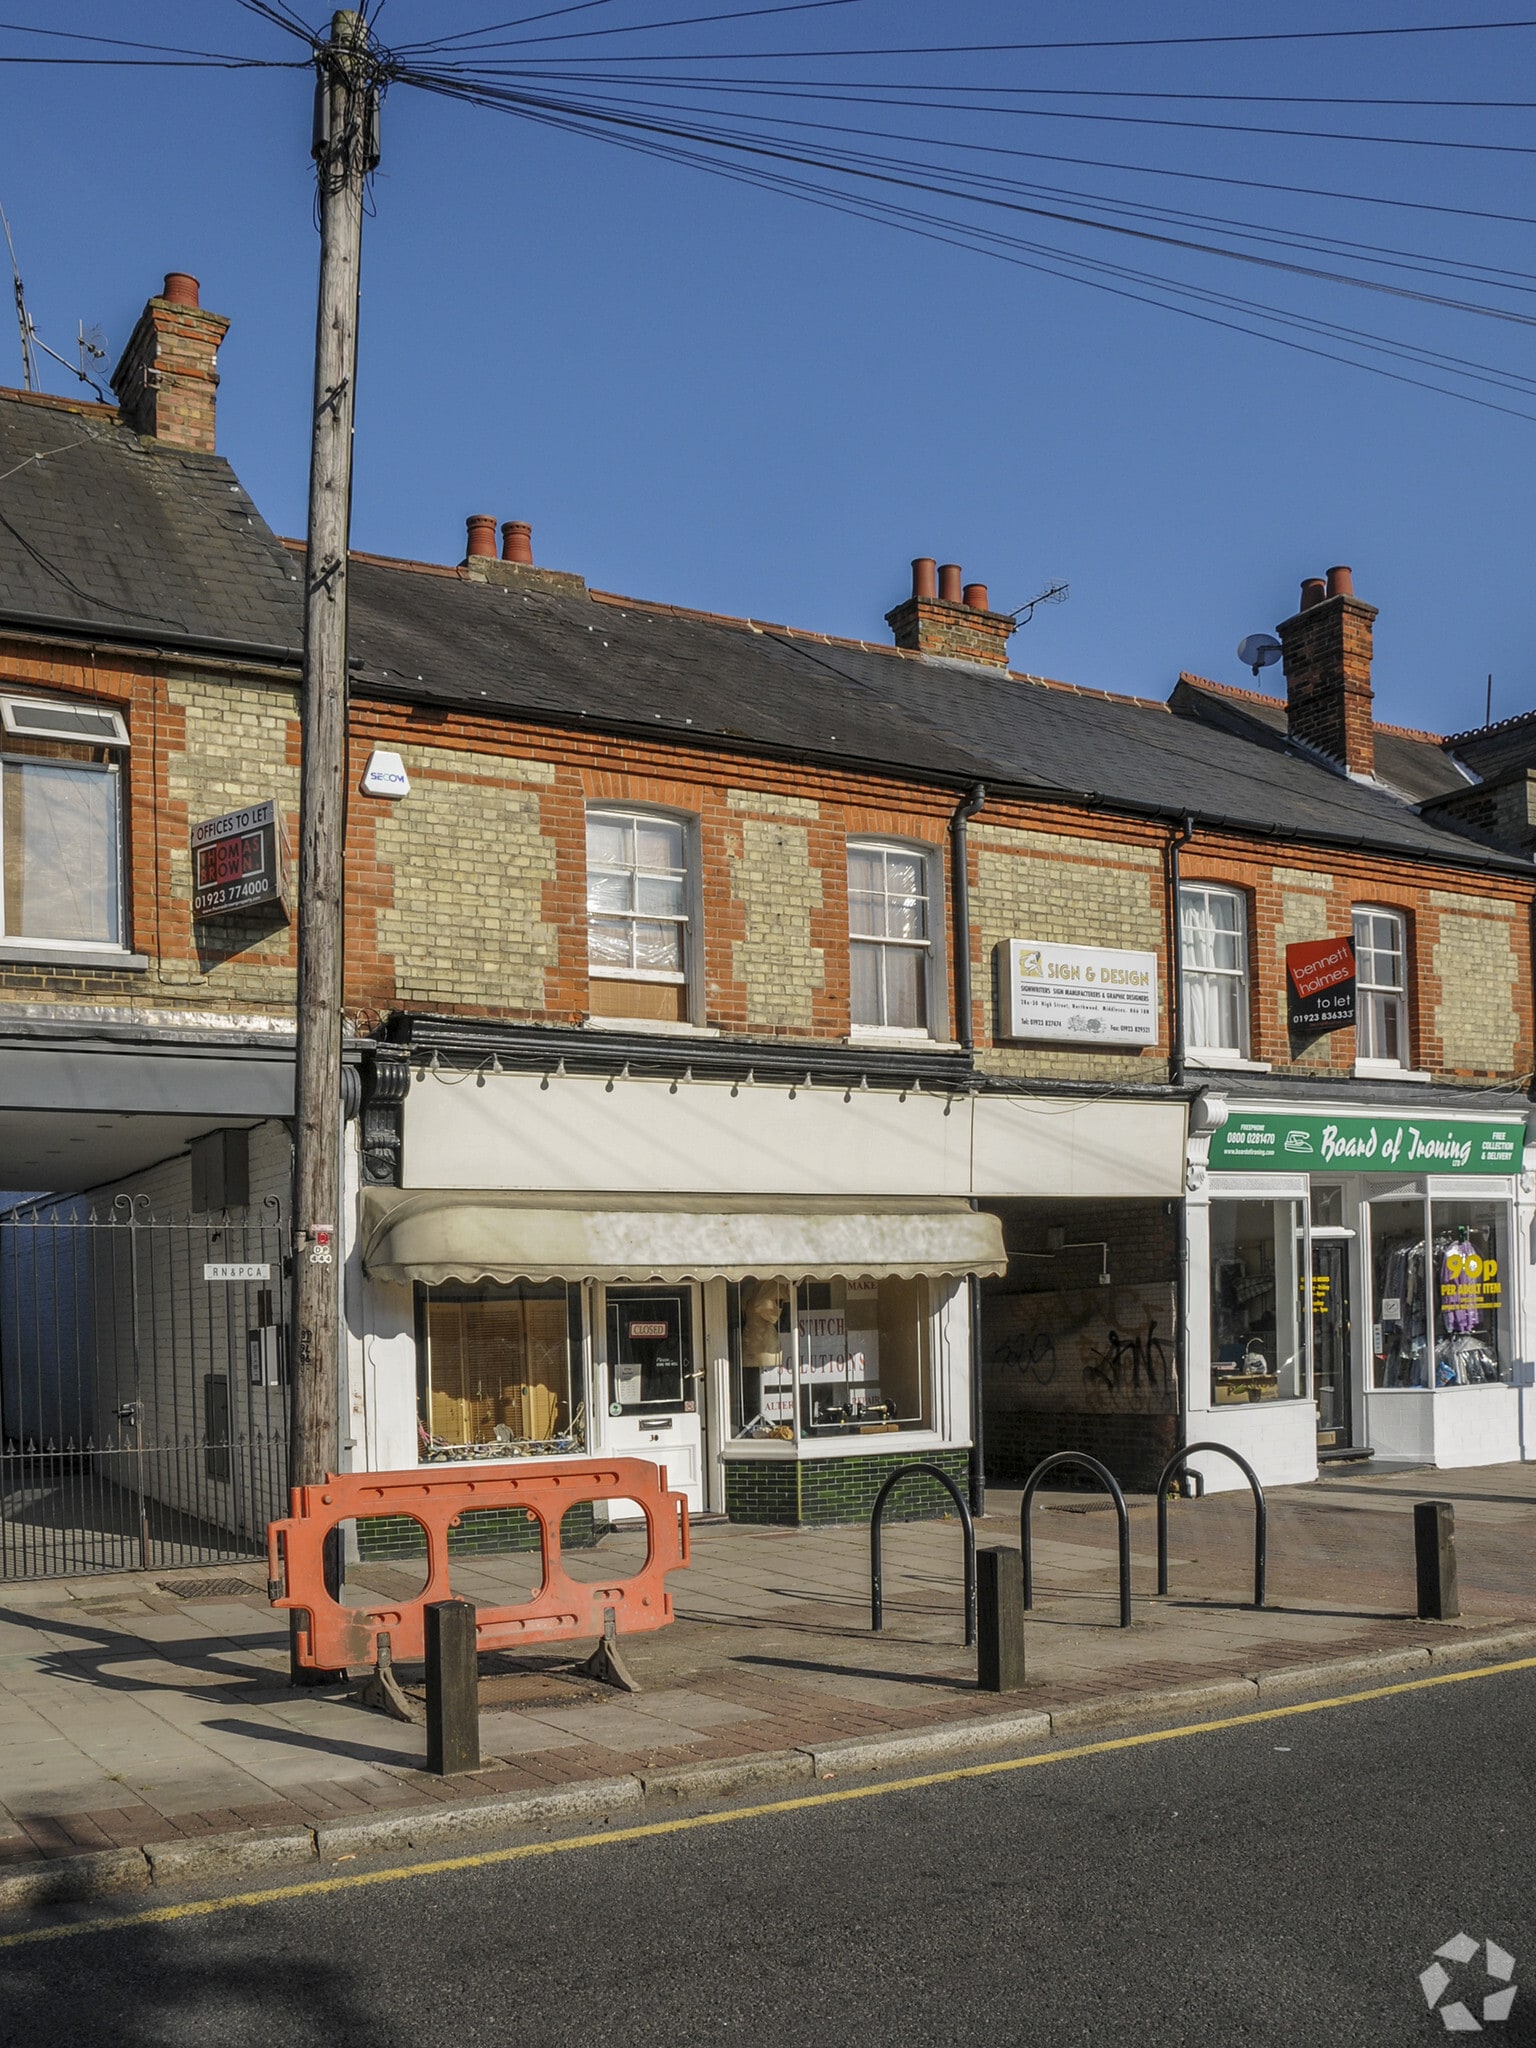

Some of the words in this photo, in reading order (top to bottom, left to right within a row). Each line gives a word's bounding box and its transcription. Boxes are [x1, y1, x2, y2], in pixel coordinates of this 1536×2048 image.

[370, 772, 405, 783] SECOM
[196, 817, 234, 841] OFFICES
[235, 812, 250, 828] TO
[252, 806, 268, 822] LET
[200, 837, 260, 867] THOMAS
[194, 890, 226, 909] 01923
[228, 878, 269, 900] 774000
[1293, 946, 1349, 979] bennett
[1047, 962, 1080, 980] SIGN
[1085, 966, 1096, 982] &
[1100, 967, 1150, 986] DESIGN
[1299, 967, 1349, 995] holmes
[1317, 998, 1330, 1009] to
[1334, 994, 1351, 1007] let
[1293, 1013, 1320, 1023] 01923
[1227, 1131, 1246, 1144] 0800
[1491, 1131, 1507, 1140] FREE
[1321, 1124, 1377, 1163] Board
[1382, 1126, 1403, 1164] of
[1408, 1126, 1472, 1166] Ironing
[1481, 1141, 1514, 1151] COLLECTION
[1486, 1151, 1513, 1161] DELIVERY
[1446, 1254, 1498, 1282] 90p
[847, 1282, 877, 1291] MAKE
[1441, 1284, 1457, 1296] PER
[1458, 1283, 1481, 1295] ADULT
[1482, 1282, 1502, 1294] ITEM
[633, 1325, 664, 1335] CLOSED
[799, 1318, 845, 1337] STITCH
